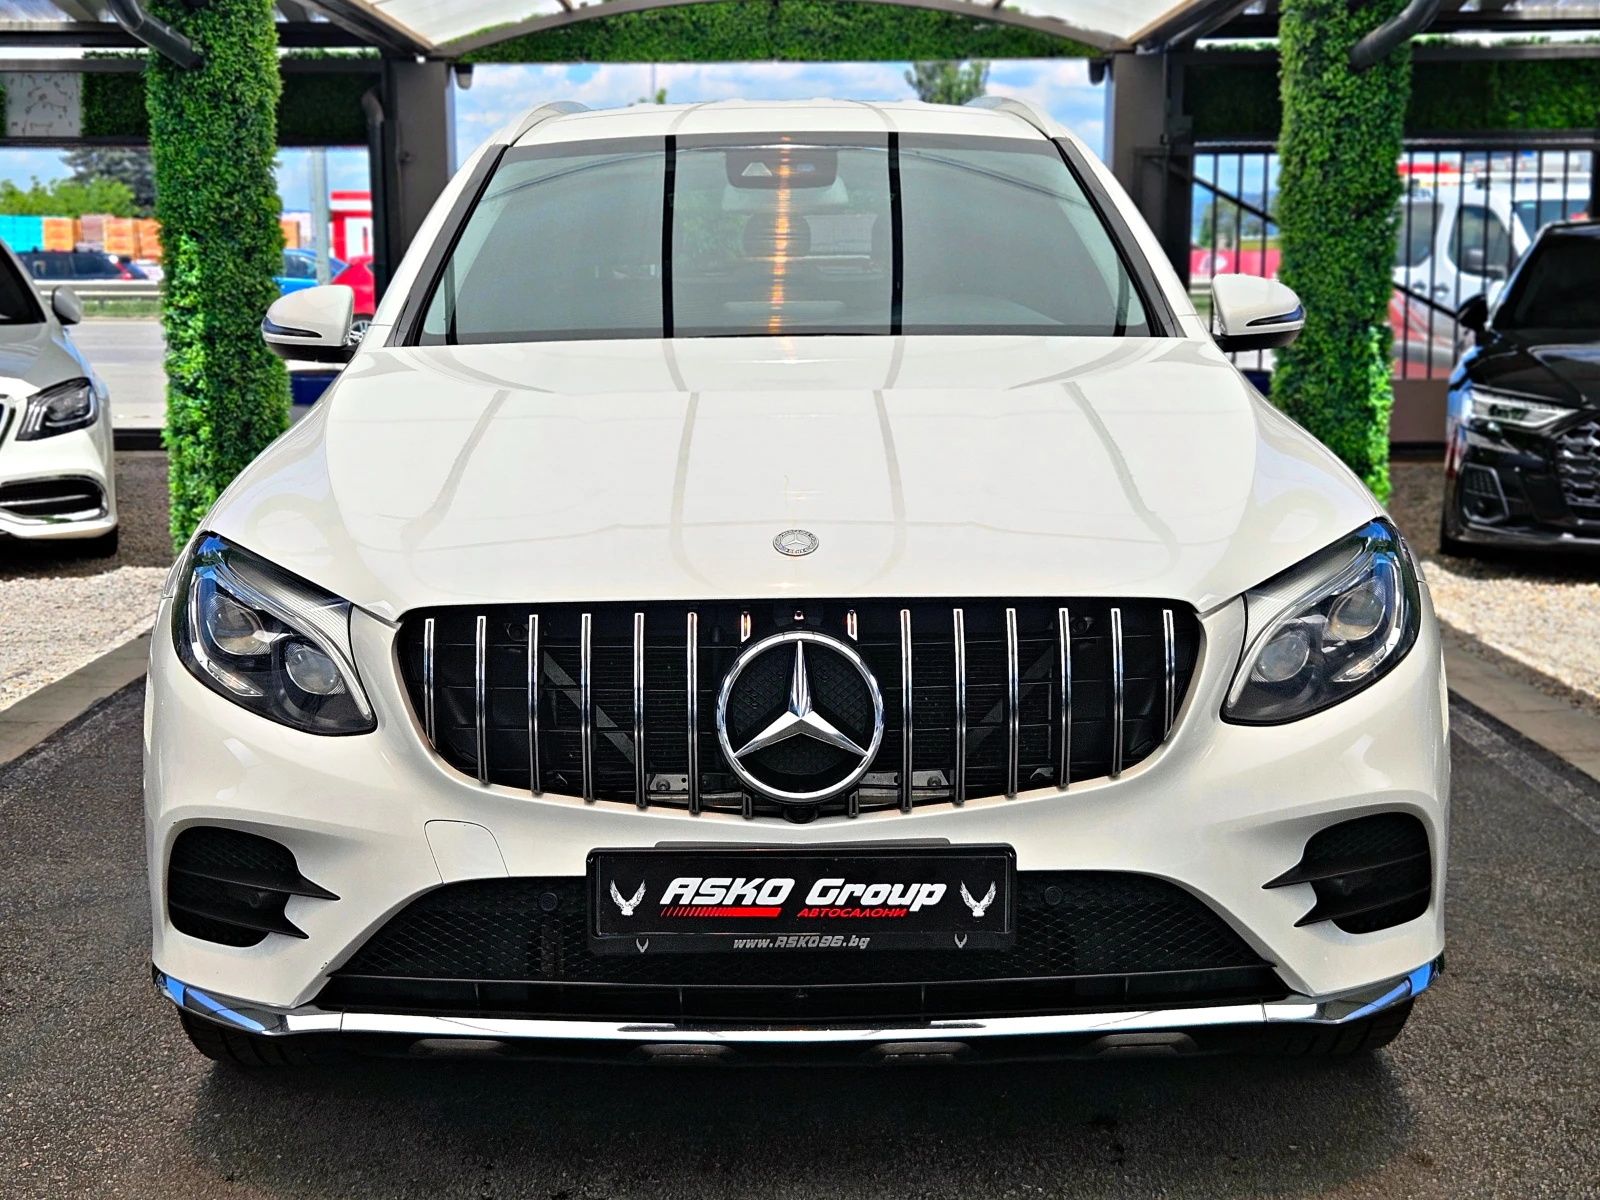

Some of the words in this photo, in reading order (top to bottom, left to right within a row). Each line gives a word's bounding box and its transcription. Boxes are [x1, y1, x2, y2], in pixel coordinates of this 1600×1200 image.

[660, 877, 795, 906] ASKO
[805, 878, 948, 912] Group
[797, 908, 908, 918] АВТОСАЛОНИ
